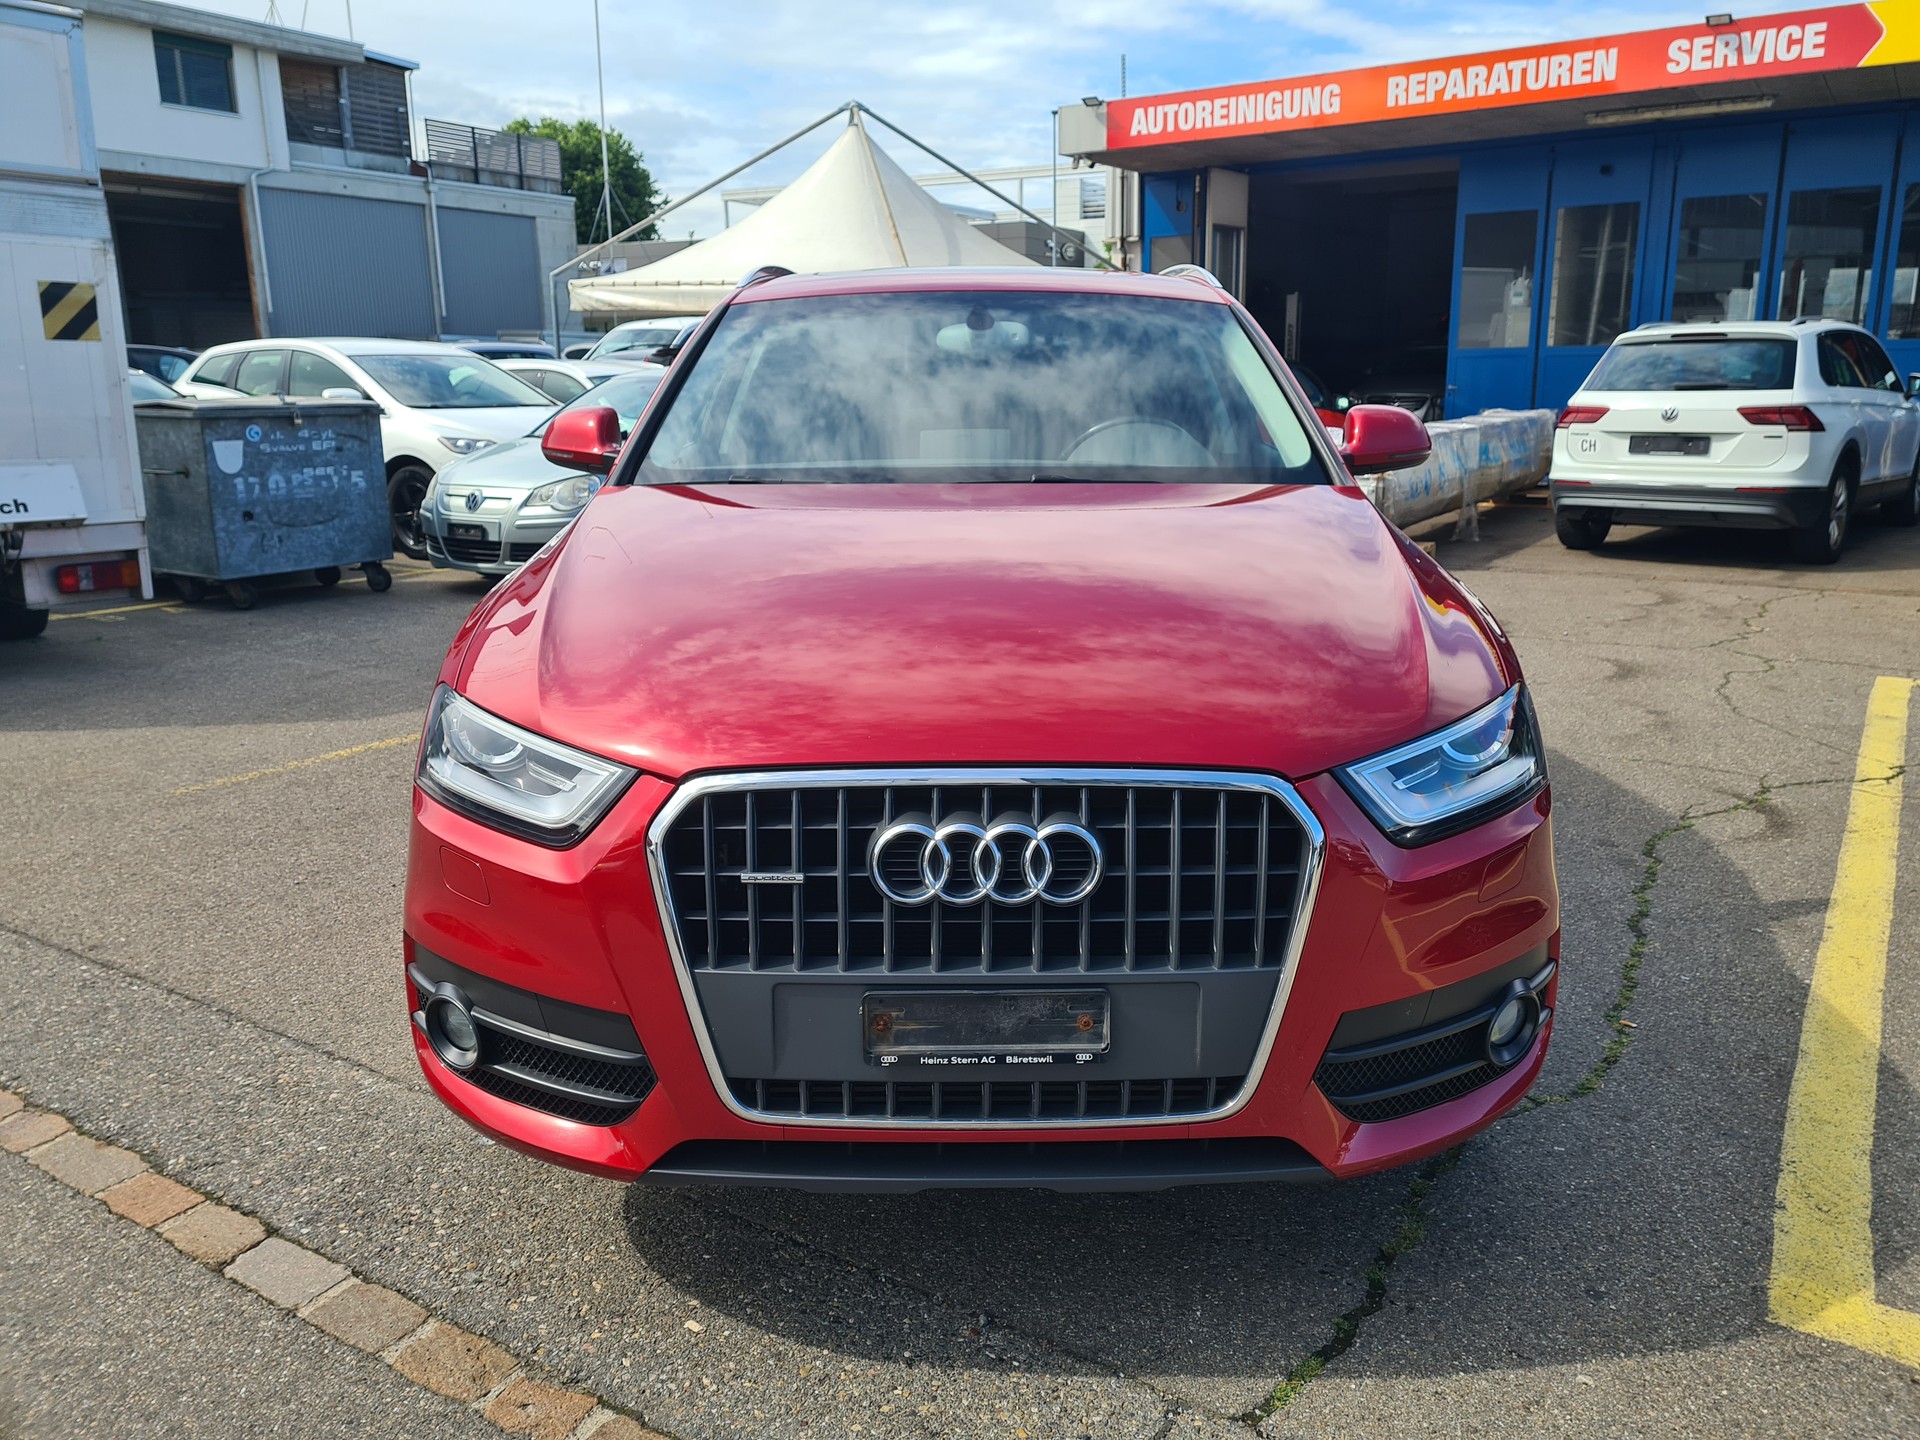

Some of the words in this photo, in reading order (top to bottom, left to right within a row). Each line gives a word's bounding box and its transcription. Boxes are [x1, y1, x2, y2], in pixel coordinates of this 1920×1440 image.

[1130, 83, 1341, 136] AUTOREINIGUNG
[1387, 47, 1619, 108] REPARATUREN
[1666, 22, 1828, 74] SERVICE
[1581, 439, 1597, 452] CH
[920, 1056, 949, 1065] Heinz
[951, 1056, 979, 1064] Stern
[981, 1056, 996, 1064] AG
[1006, 1055, 1053, 1064] Bäretswil
